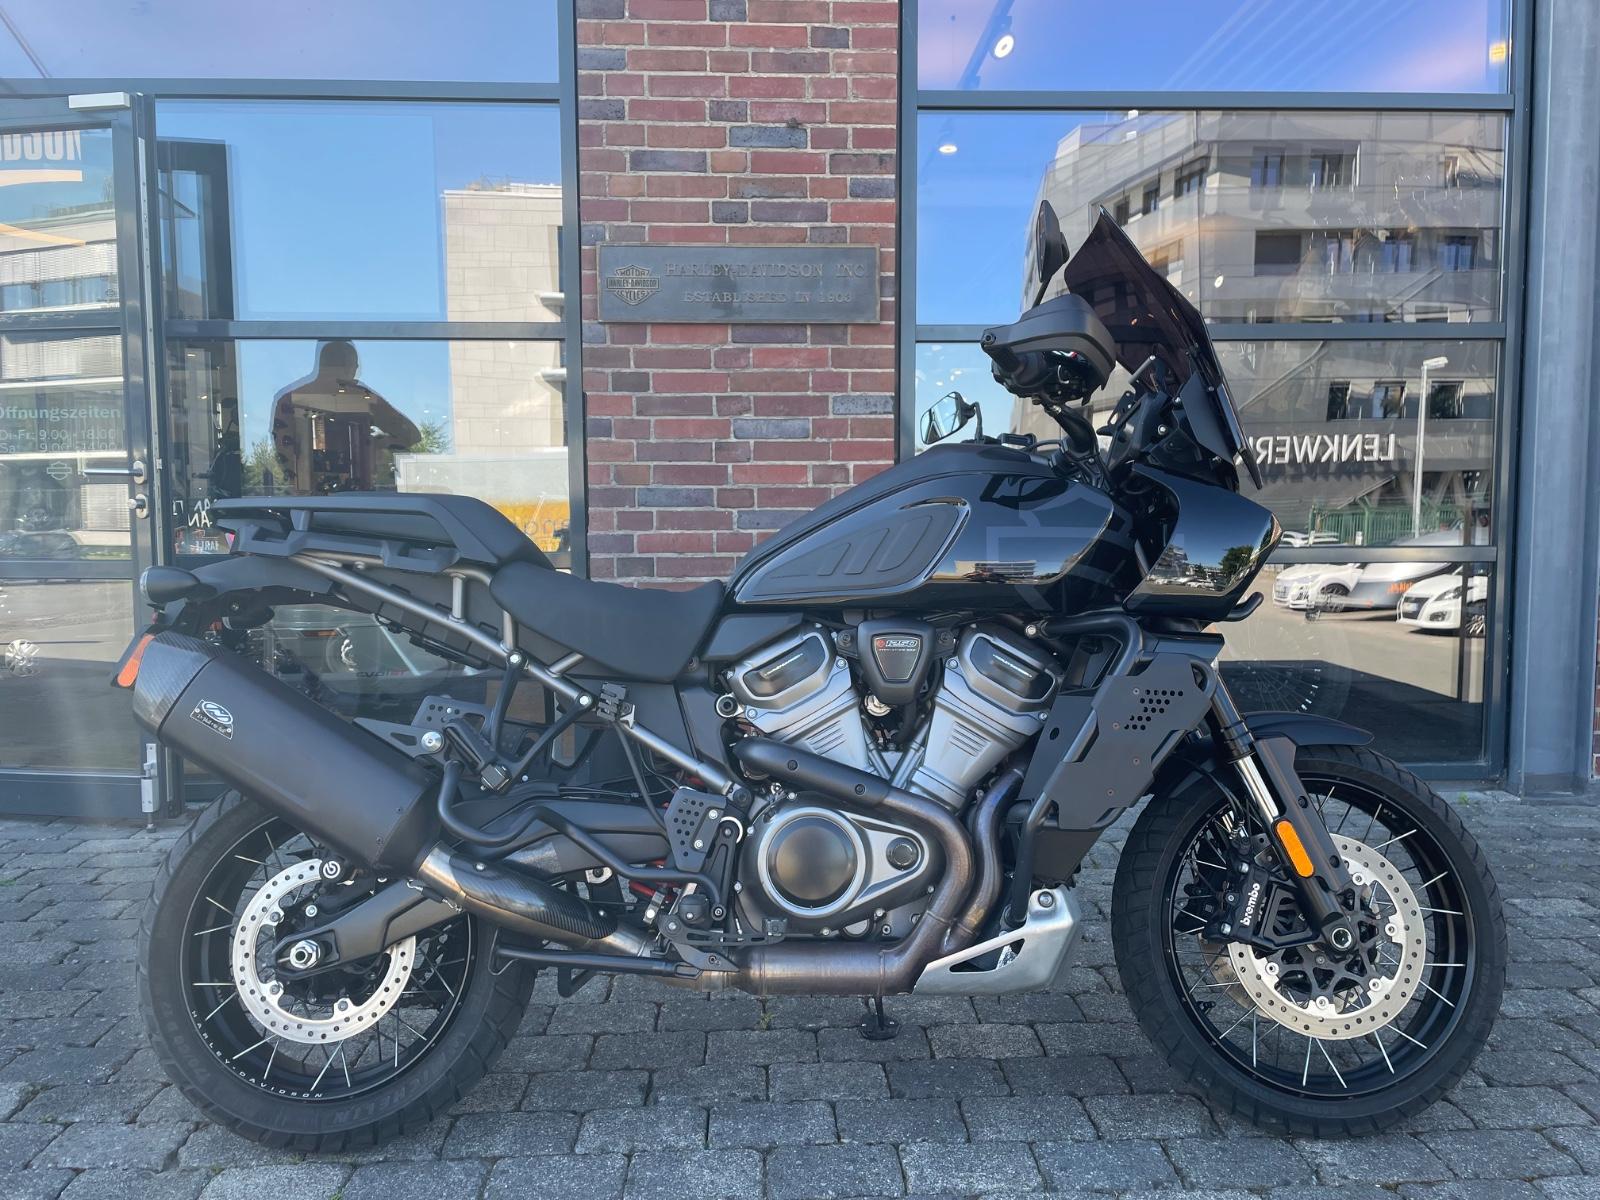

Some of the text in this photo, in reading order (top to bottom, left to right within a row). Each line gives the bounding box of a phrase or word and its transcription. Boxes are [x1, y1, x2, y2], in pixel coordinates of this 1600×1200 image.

[619, 268, 646, 276] MOTOR
[664, 263, 824, 278] HARLEY-DAVIDSON
[608, 278, 658, 288] HARLEY-DAVIDSON
[620, 289, 646, 301] CYCLES
[683, 291, 787, 303] ESTABLISHED
[0, 405, 121, 423] ffnungszeiten
[1240, 883, 1260, 926] brembo
[190, 1009, 323, 1099] HARLEY-DAVIDSON
